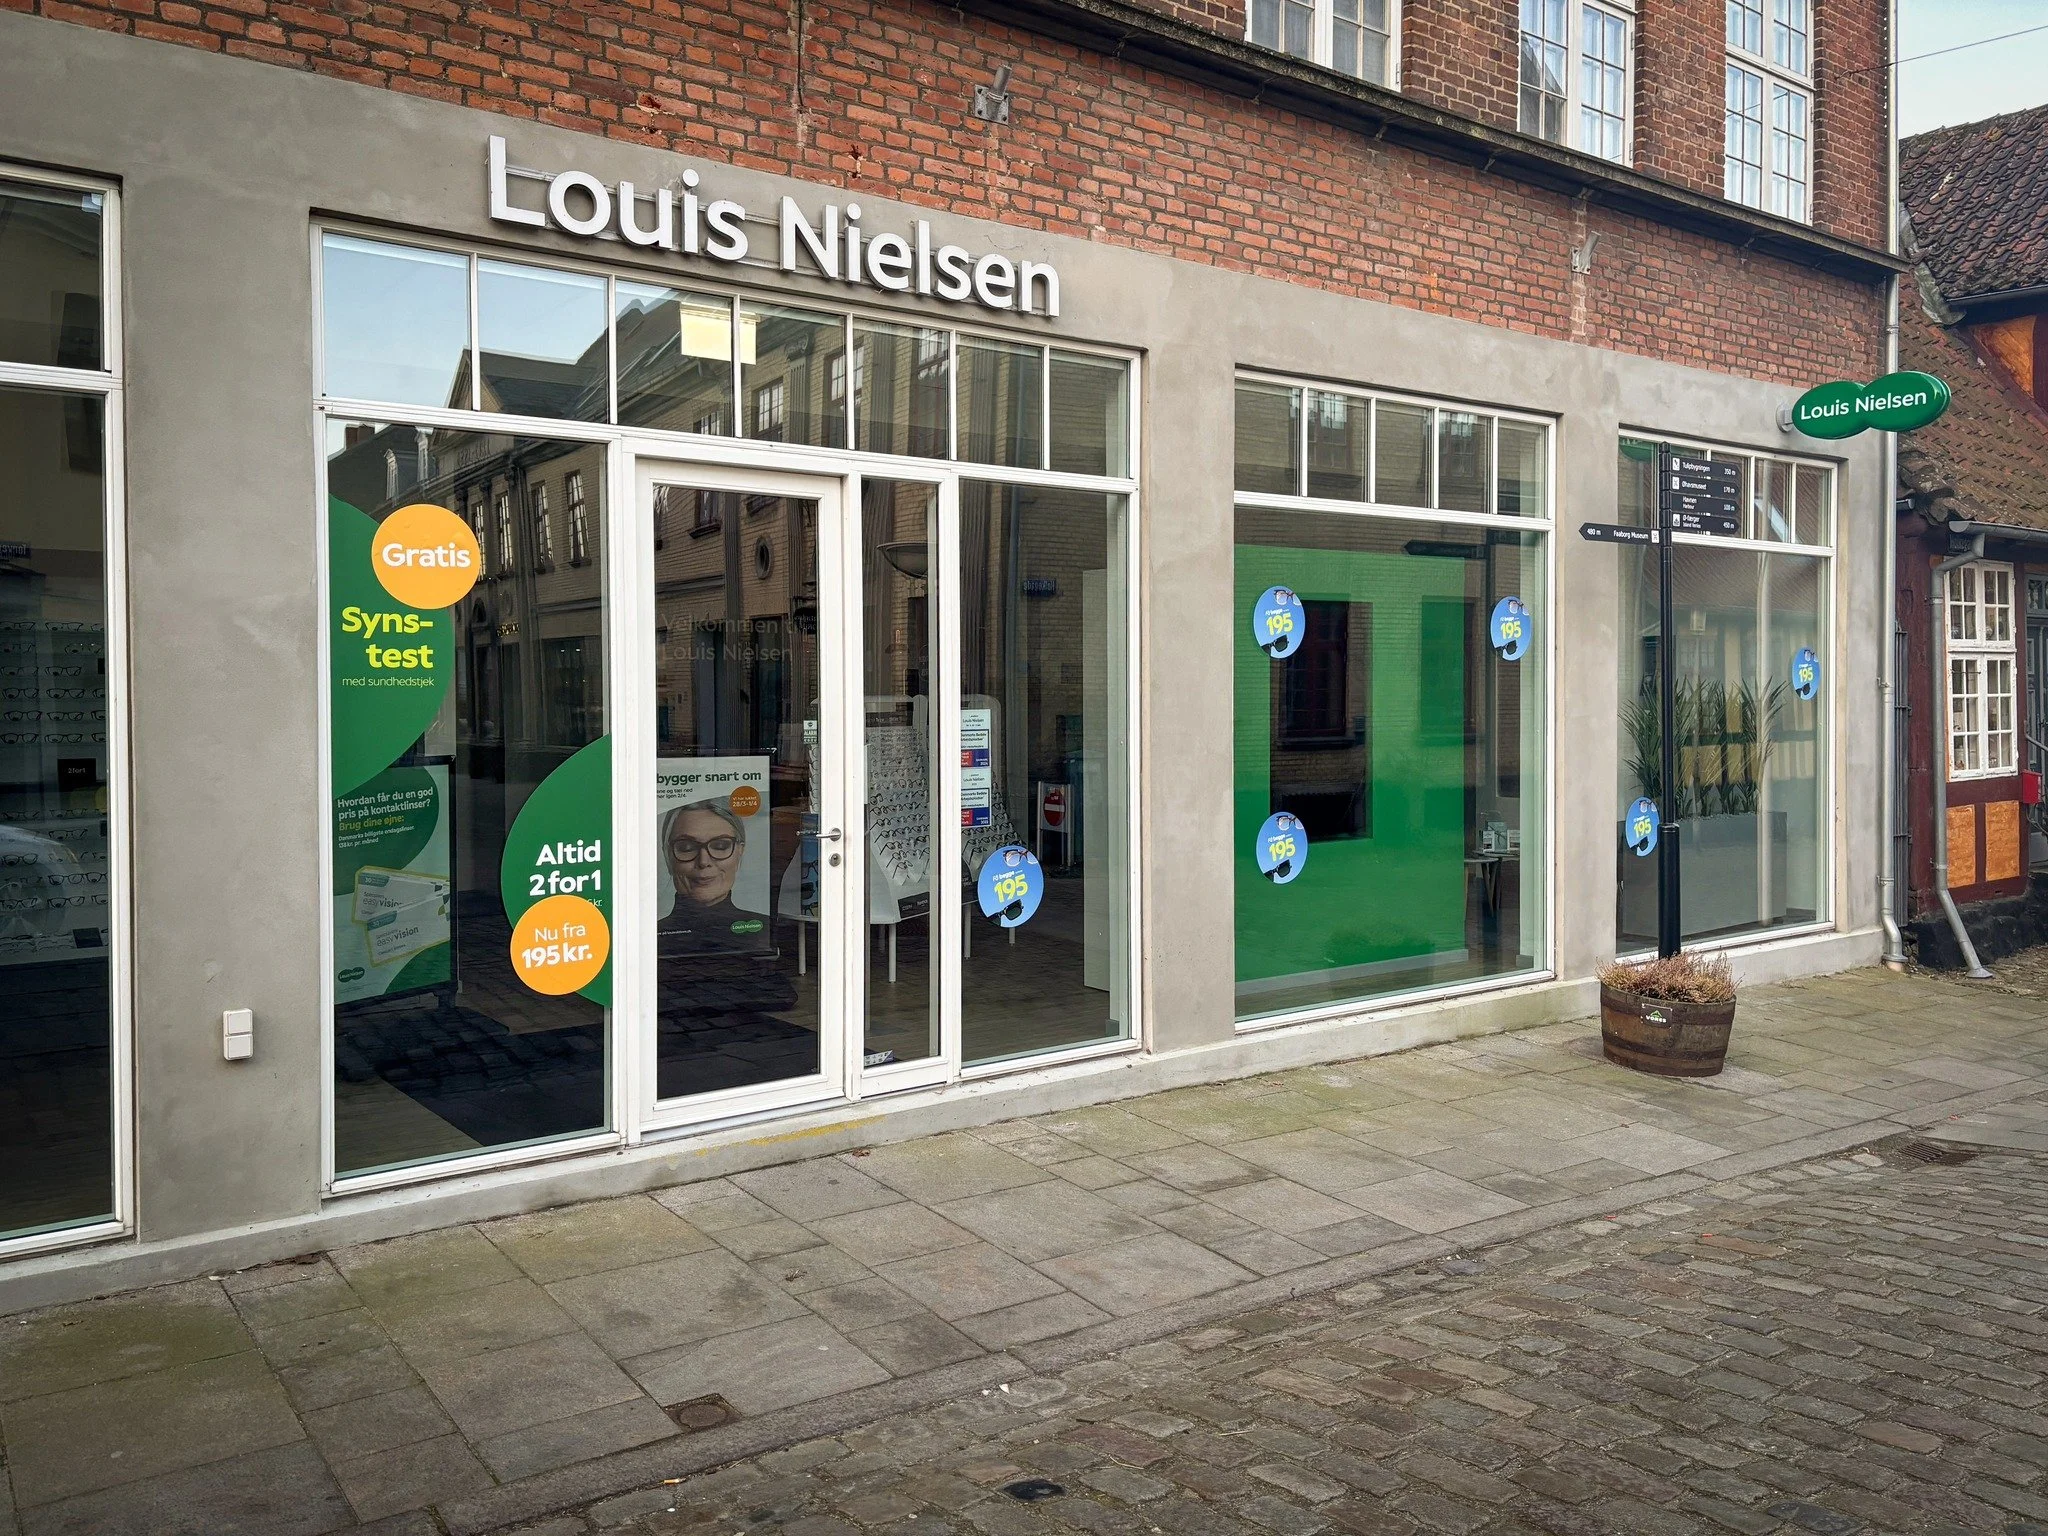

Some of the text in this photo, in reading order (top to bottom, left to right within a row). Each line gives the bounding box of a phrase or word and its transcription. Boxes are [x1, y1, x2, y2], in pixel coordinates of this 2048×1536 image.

[487, 135, 1060, 317] Louis Nielsen
[1800, 392, 1927, 420] Louis Nielsen
[1613, 530, 1630, 539] Faaborg
[382, 542, 471, 568] Gratis
[342, 606, 433, 639] Syns-
[1266, 612, 1293, 636] 195
[1501, 620, 1522, 640] 195
[365, 643, 434, 669] test
[663, 641, 791, 662] Louis Nielsen
[342, 676, 434, 688] med sundhedstjek
[1798, 667, 1814, 683] 195
[657, 770, 762, 786] bygger snart om
[337, 787, 434, 808] Hvordan får du en god
[338, 798, 431, 821] pris på kontaktlinser?
[339, 815, 405, 831] Brug dine øjne:
[1633, 818, 1652, 838] 195
[535, 839, 601, 866] Altid
[1268, 837, 1296, 862] 195
[994, 873, 1028, 904] 195
[534, 922, 586, 943] Nu fra
[521, 942, 592, 969] 195 kr.
